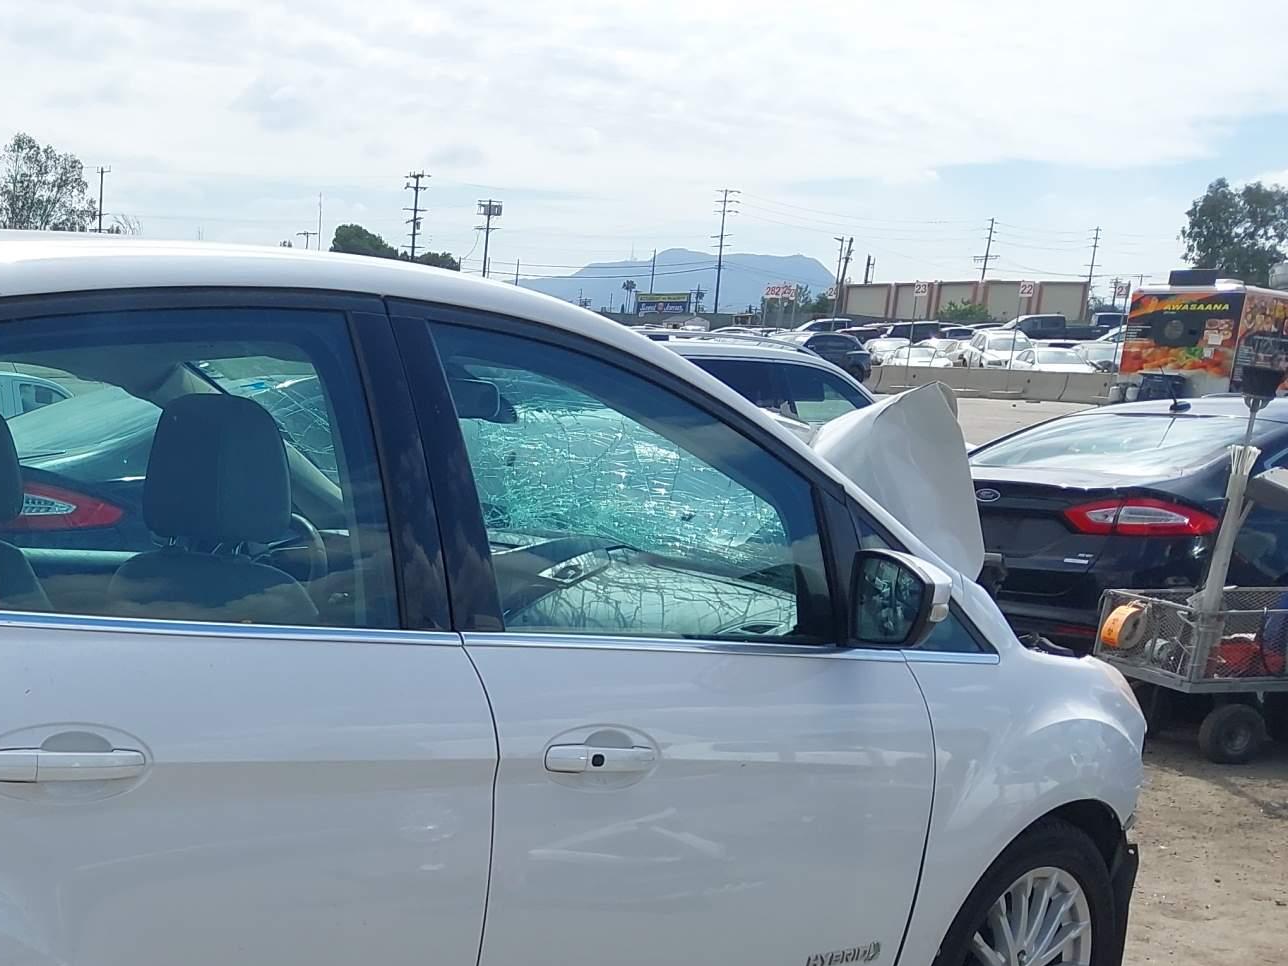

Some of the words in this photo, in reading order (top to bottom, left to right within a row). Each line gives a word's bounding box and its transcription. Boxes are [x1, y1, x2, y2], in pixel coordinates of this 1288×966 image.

[766, 286, 781, 296] 282
[915, 284, 927, 294] 23
[1021, 284, 1033, 294] 22
